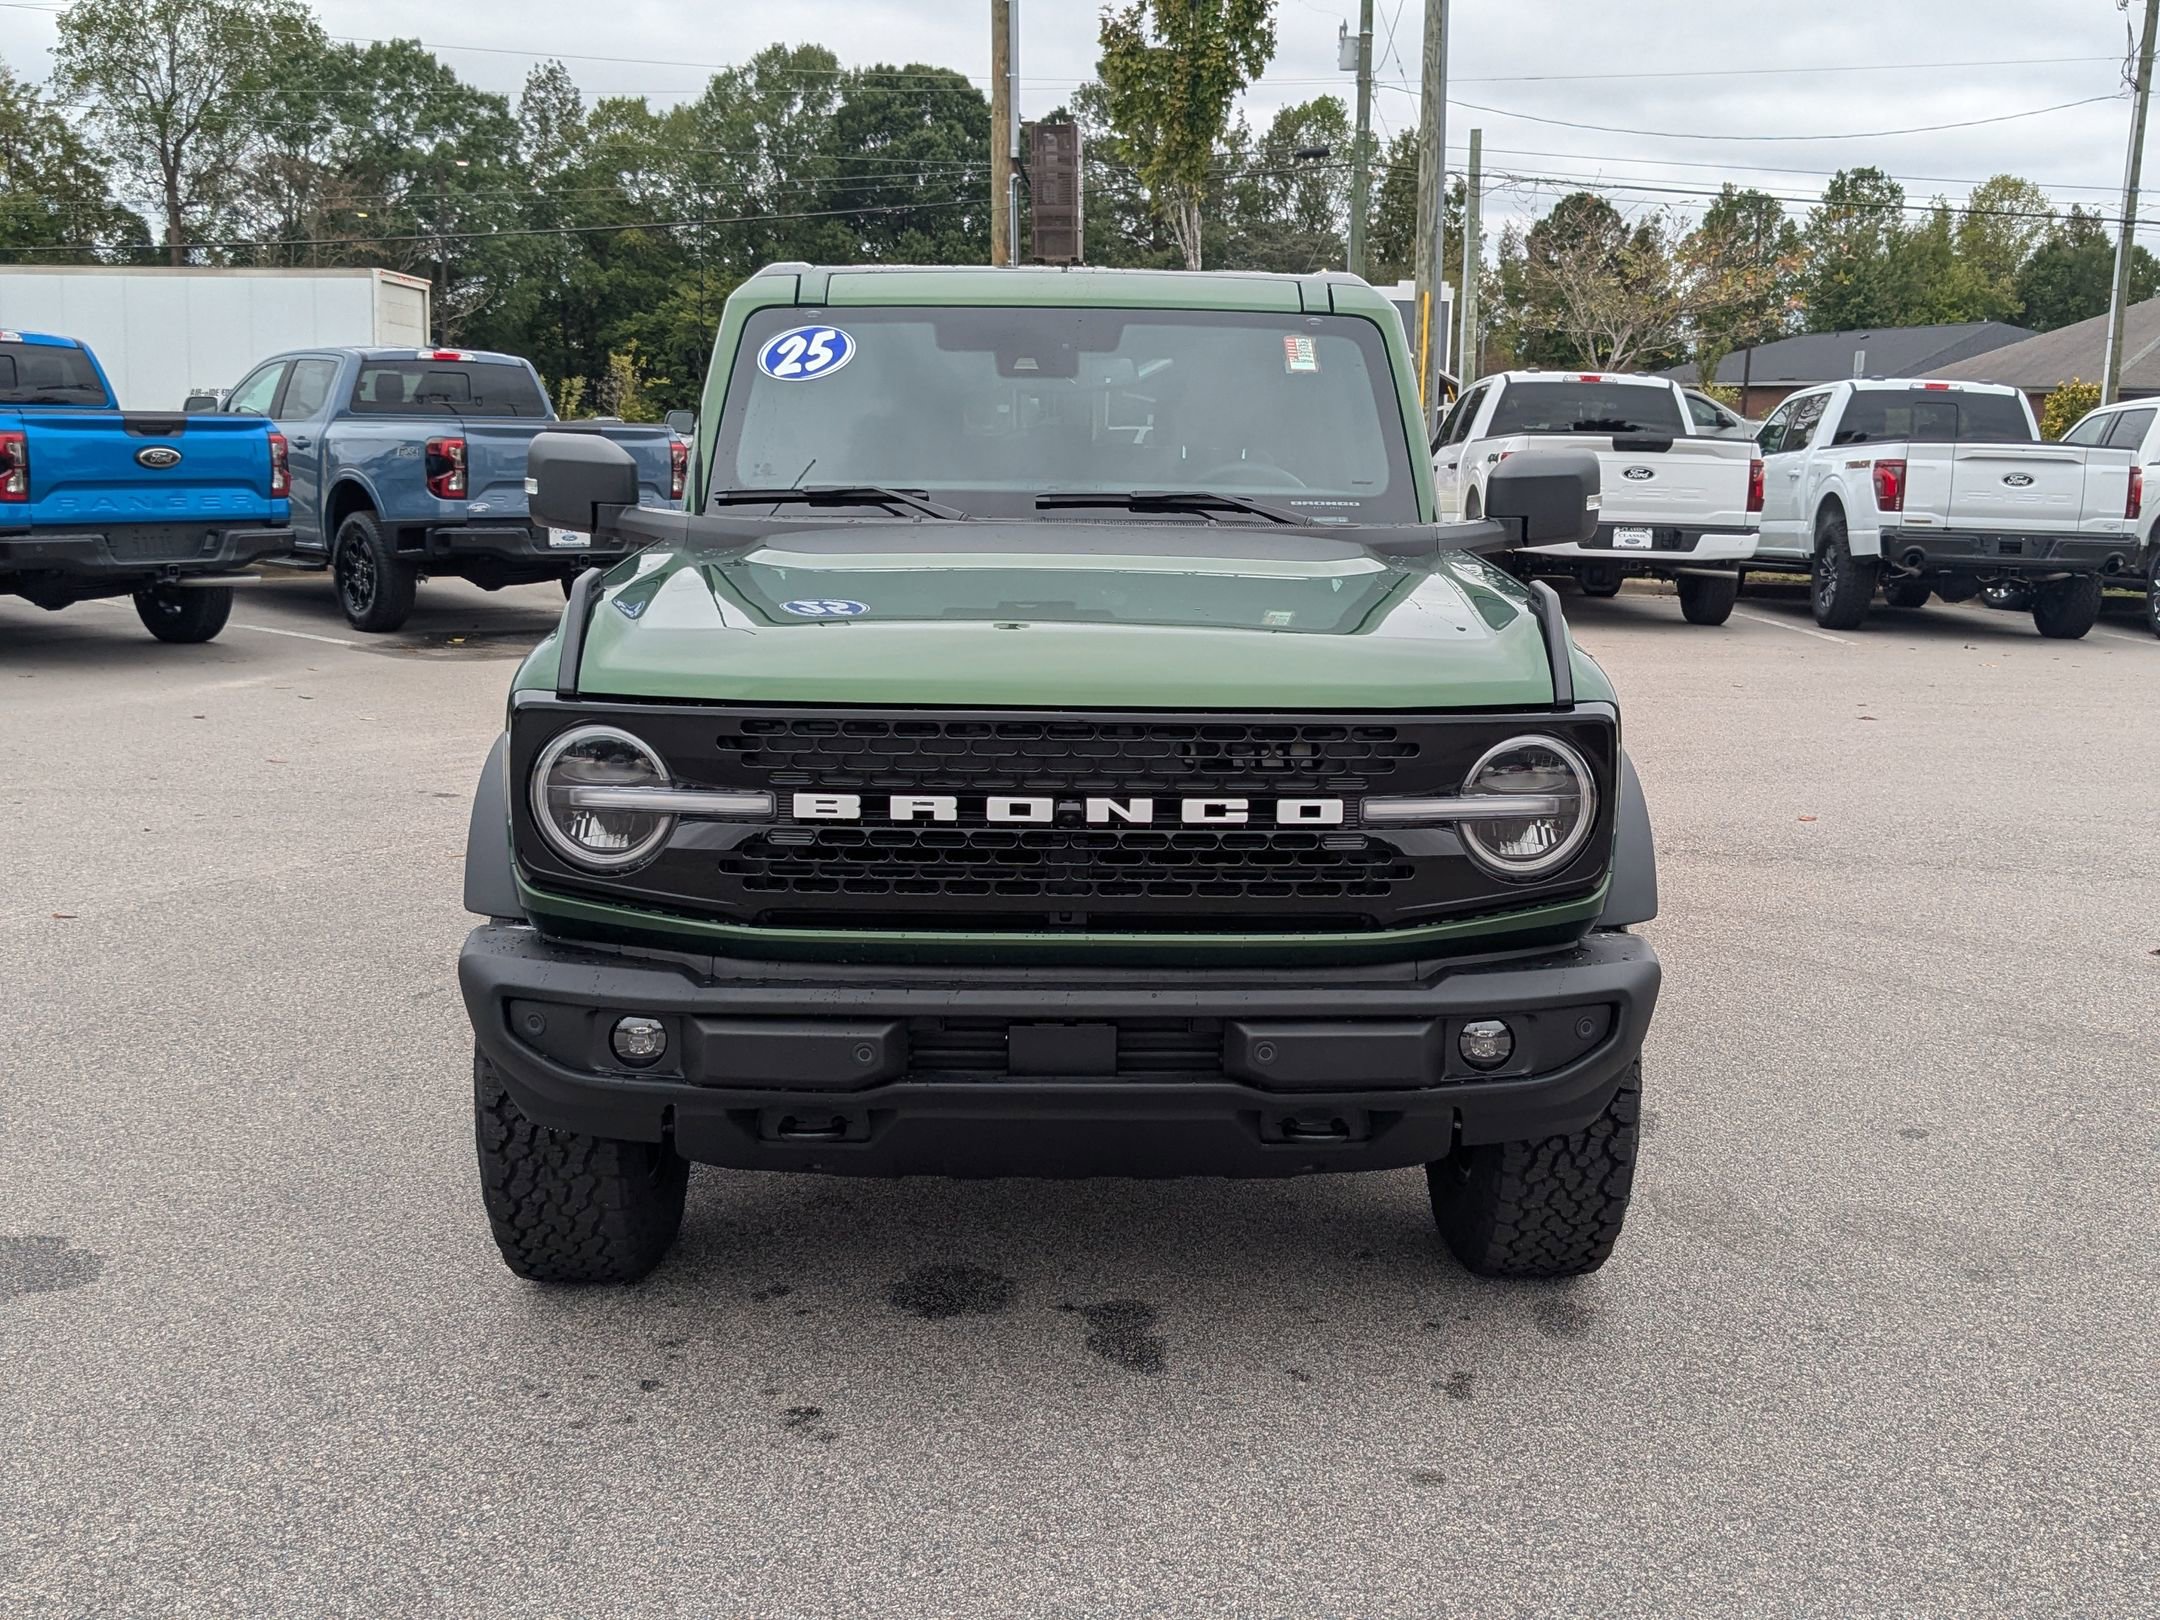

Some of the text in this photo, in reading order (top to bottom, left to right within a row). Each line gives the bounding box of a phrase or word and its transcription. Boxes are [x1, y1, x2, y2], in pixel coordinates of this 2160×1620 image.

[772, 329, 836, 376] 25
[1627, 467, 1650, 479] Ford
[2007, 475, 2029, 485] Ford
[56, 494, 252, 512] RANGER
[792, 793, 1344, 824] BRONCO
